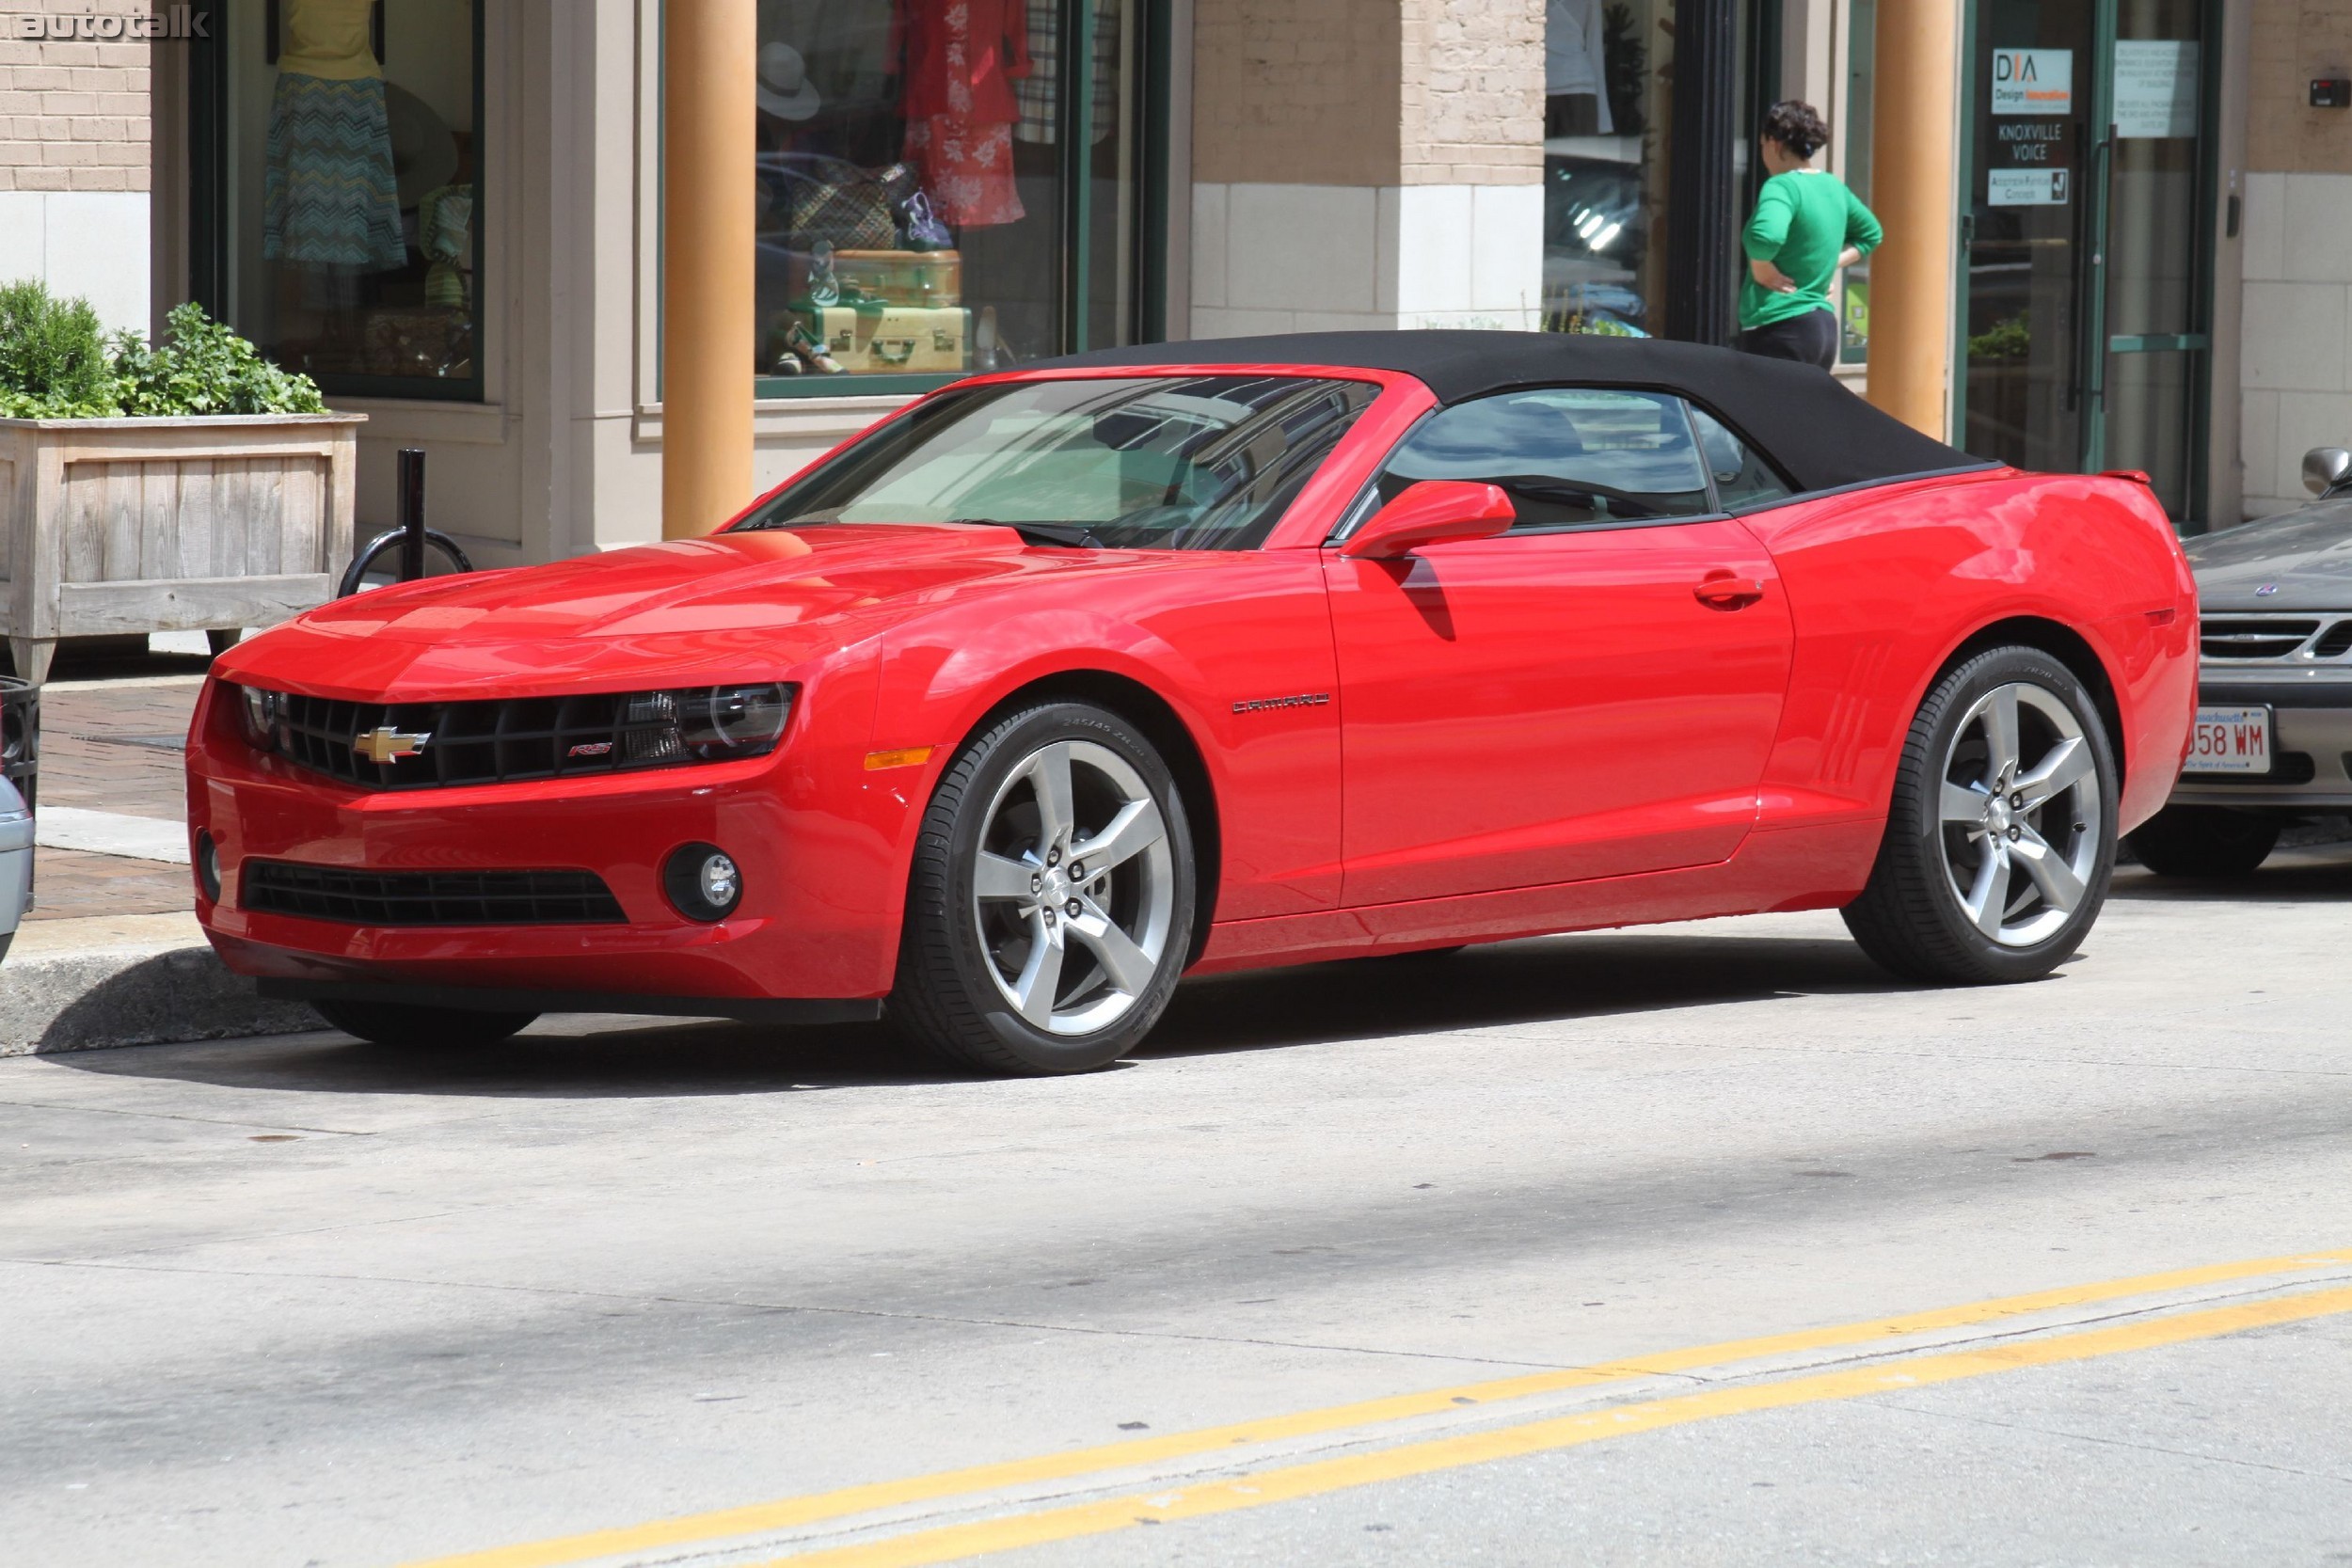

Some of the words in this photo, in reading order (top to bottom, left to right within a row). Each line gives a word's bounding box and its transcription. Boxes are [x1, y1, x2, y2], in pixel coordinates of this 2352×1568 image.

[1995, 88, 2024, 103] Design
[1998, 123, 2061, 140] KNOXVILLE
[2012, 143, 2046, 160] VOICE
[1232, 693, 1329, 712] CAMARO
[2234, 724, 2264, 755] WM
[567, 741, 613, 757] RS
